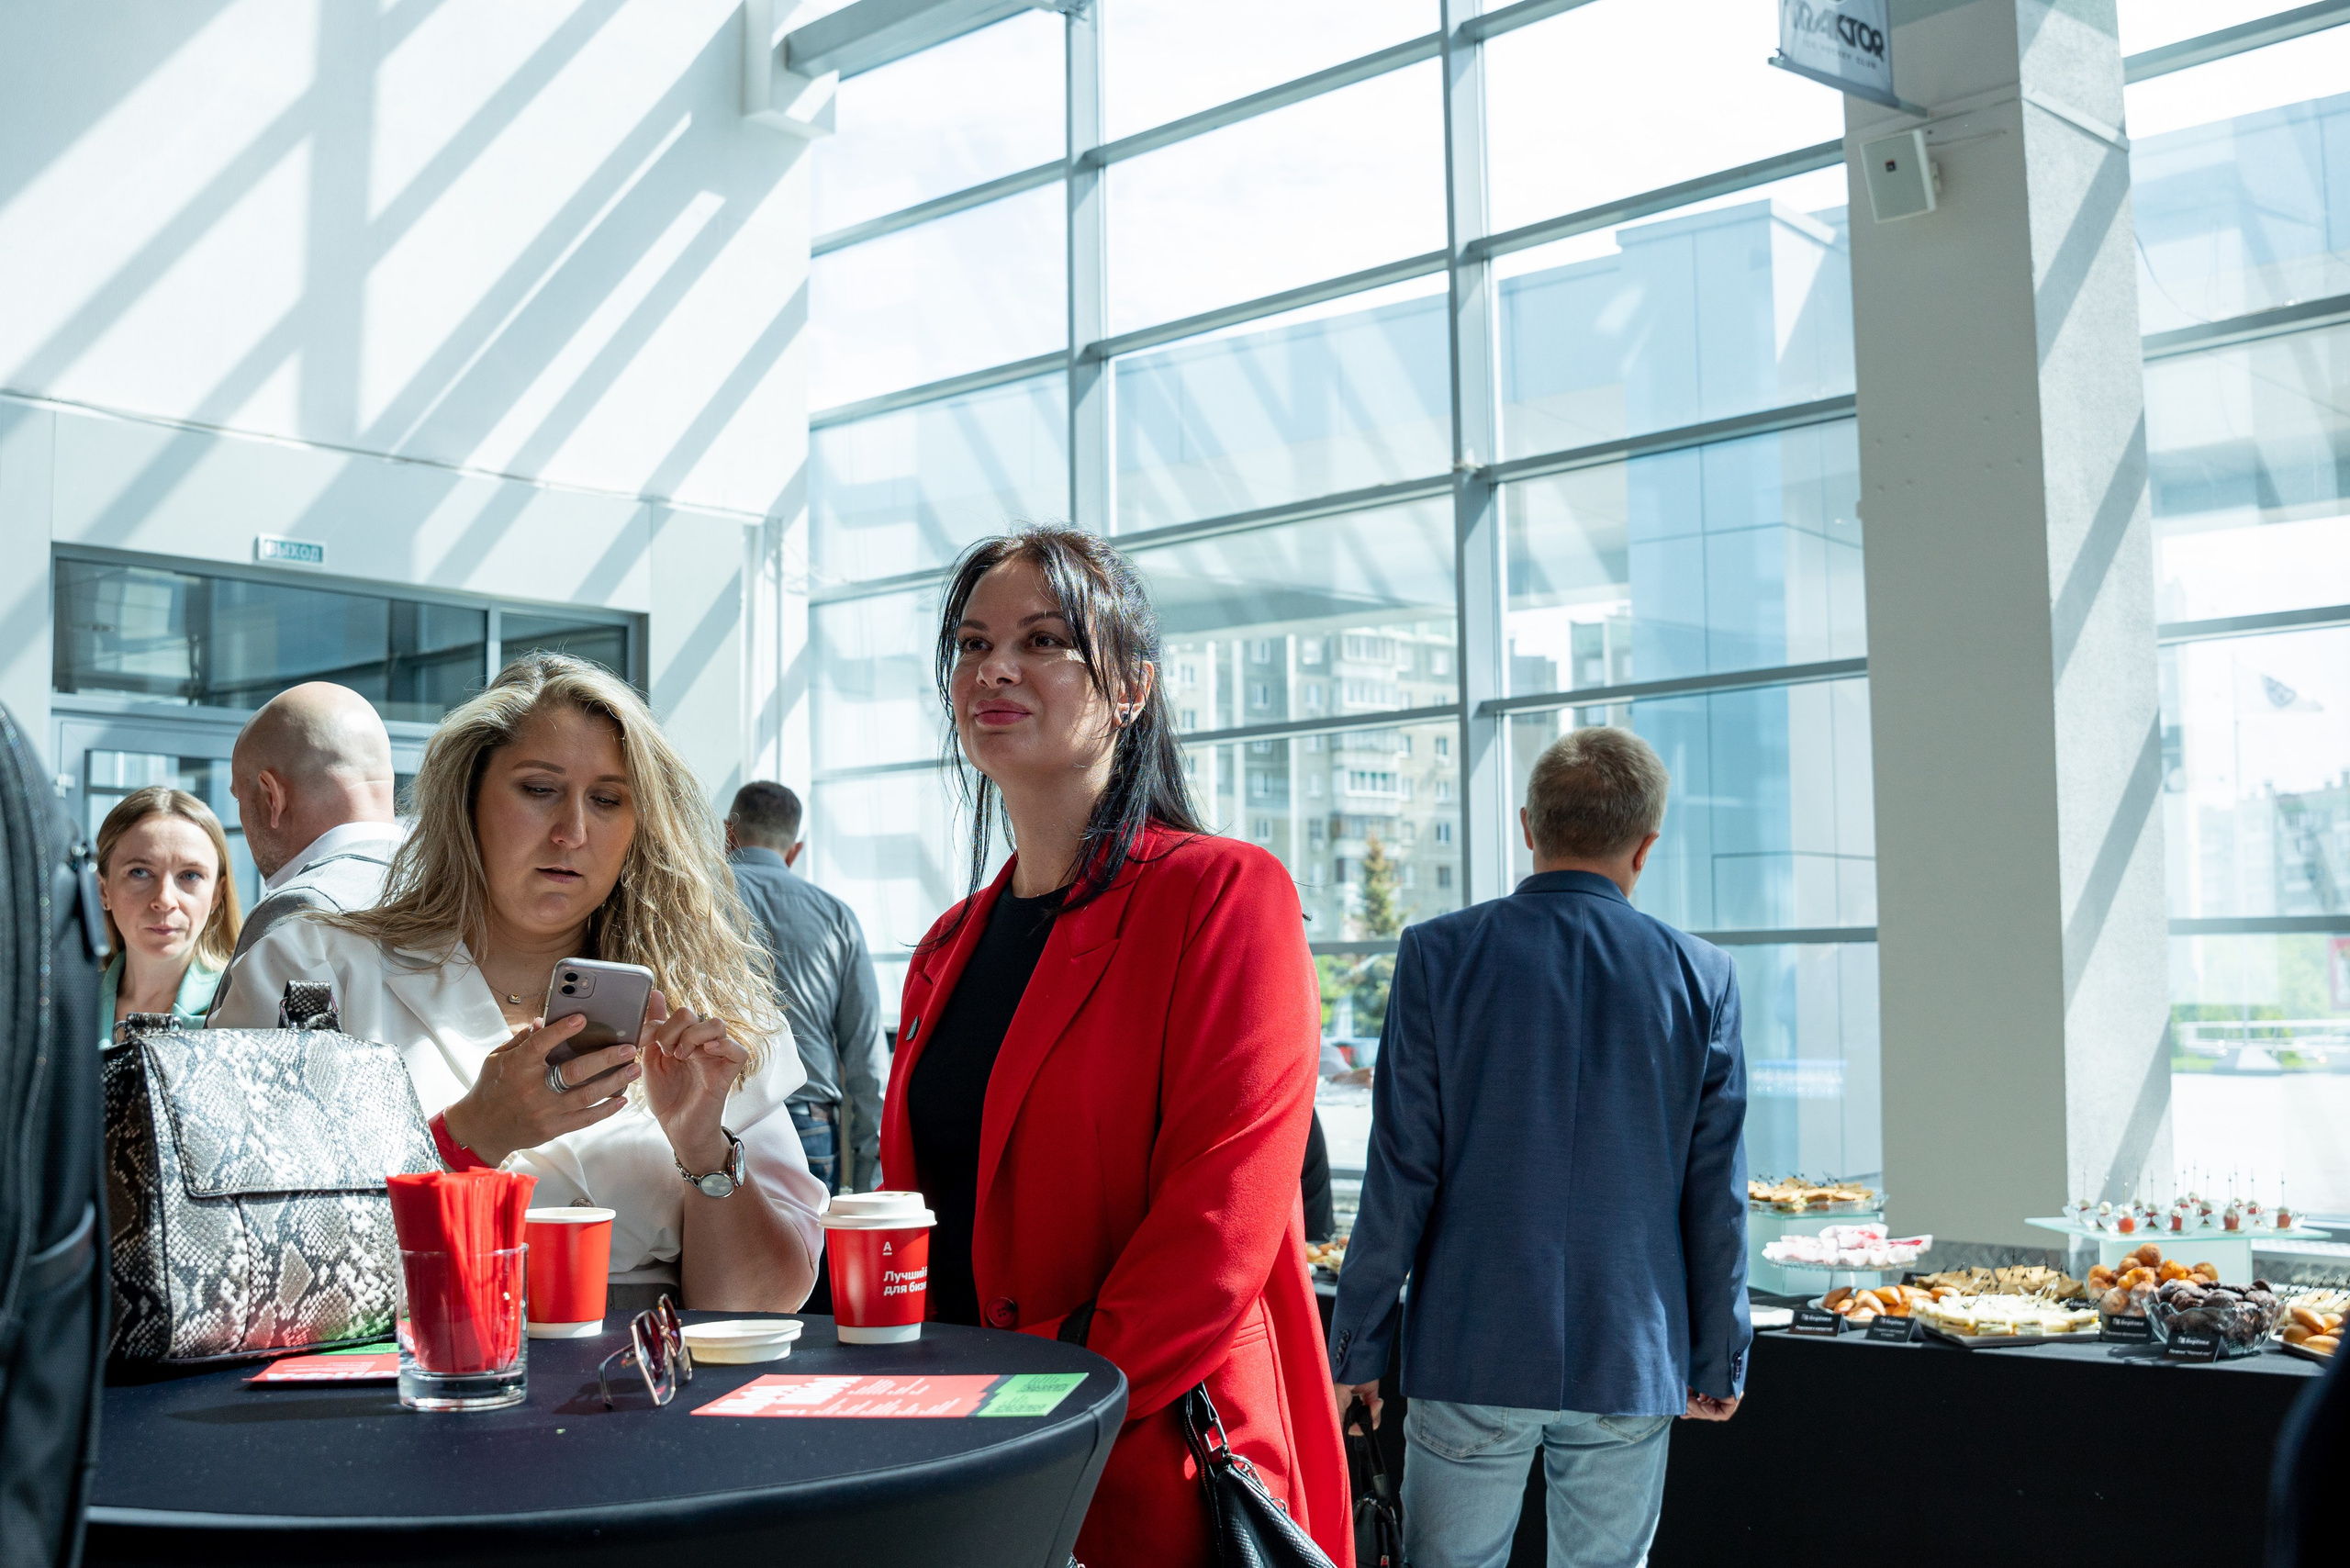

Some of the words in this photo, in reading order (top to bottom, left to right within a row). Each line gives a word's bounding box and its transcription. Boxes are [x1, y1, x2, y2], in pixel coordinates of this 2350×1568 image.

[264, 541, 319, 561] ВЫХОД
[883, 1266, 924, 1283] Лучший
[883, 1284, 907, 1296] для
